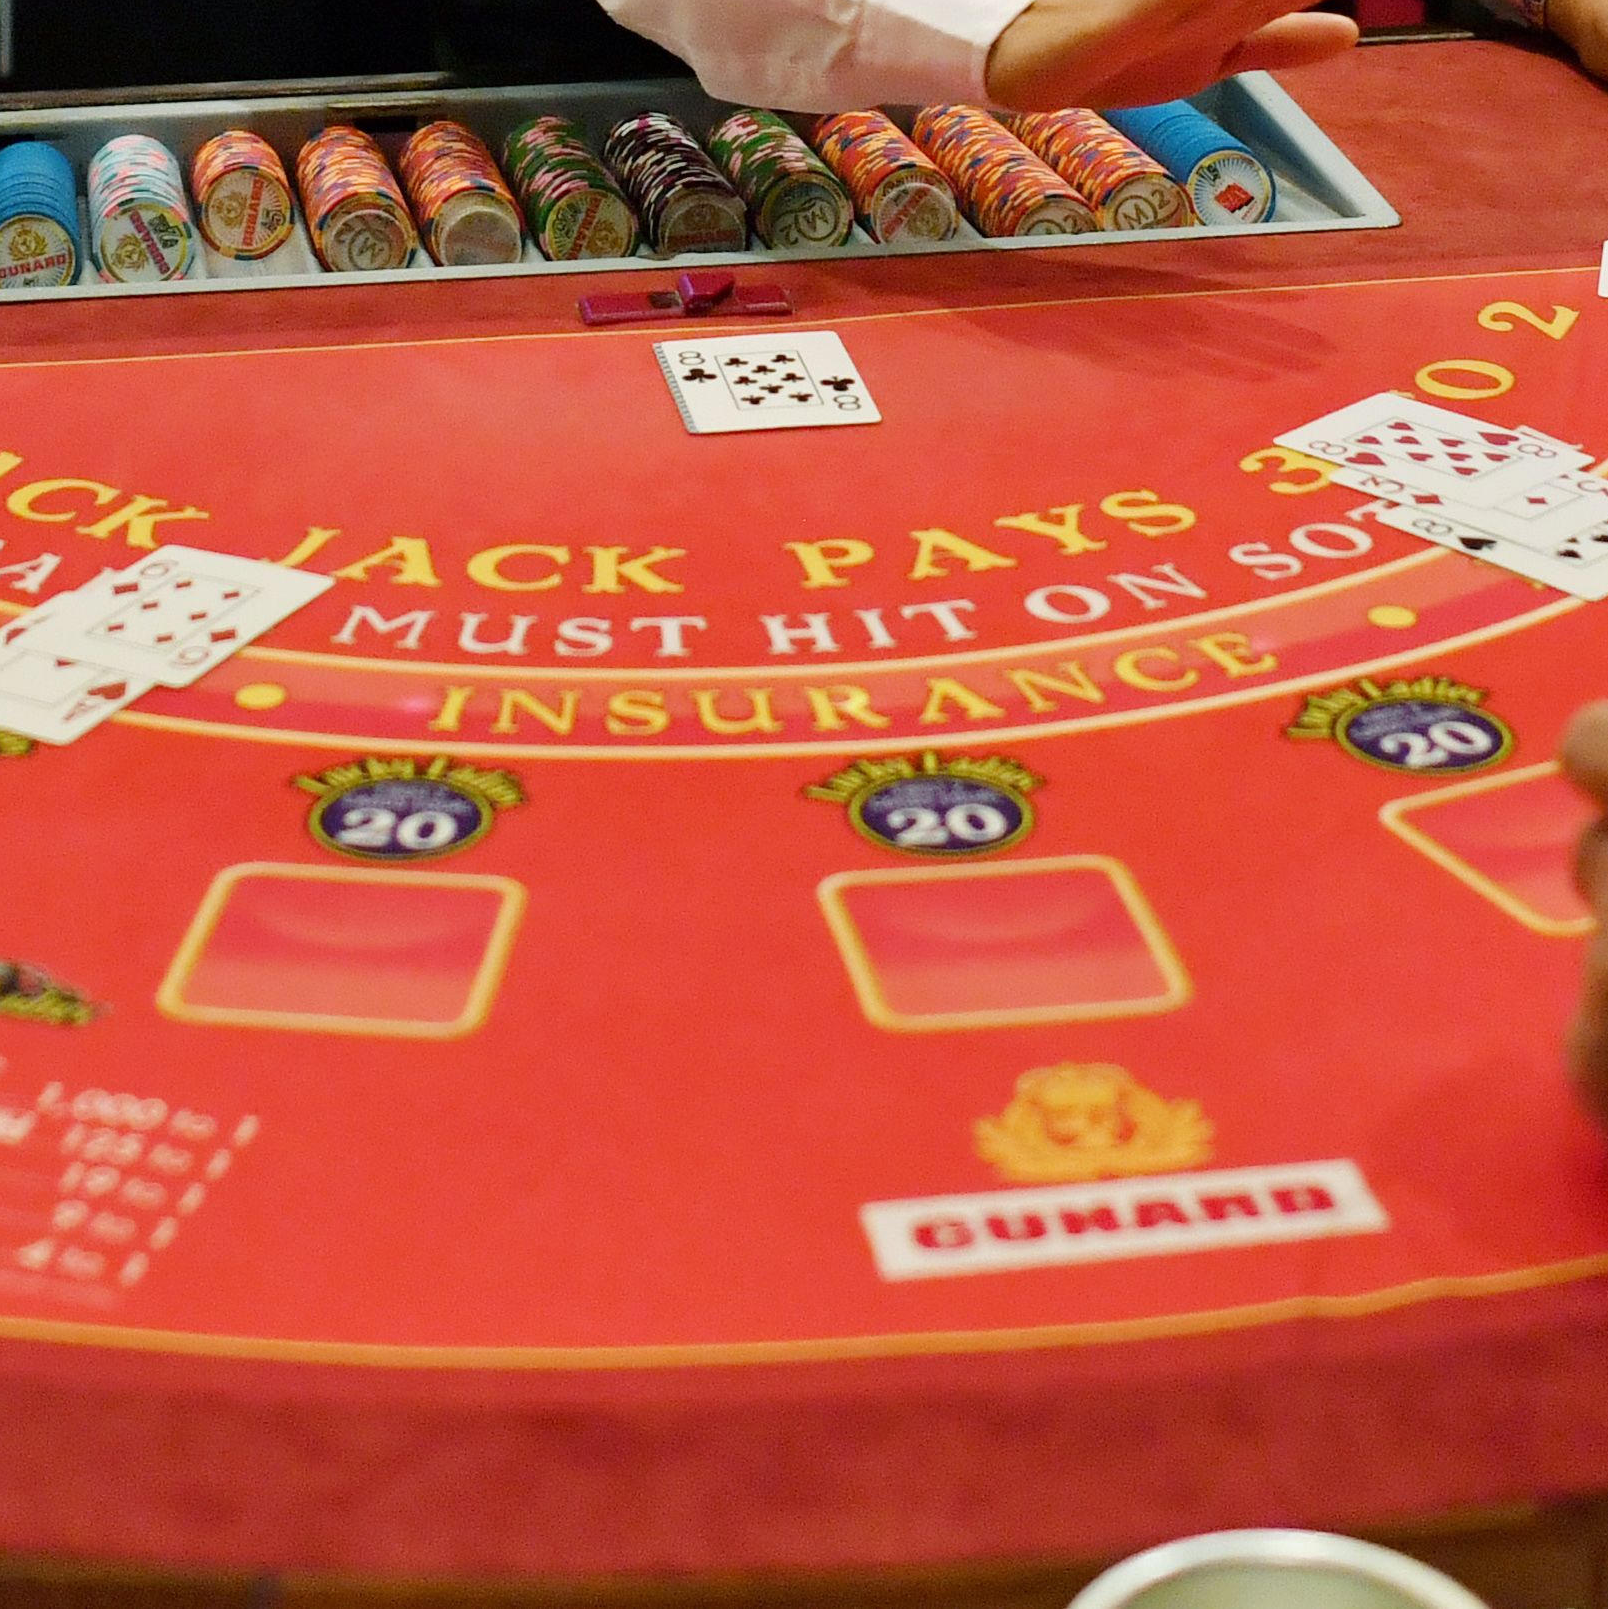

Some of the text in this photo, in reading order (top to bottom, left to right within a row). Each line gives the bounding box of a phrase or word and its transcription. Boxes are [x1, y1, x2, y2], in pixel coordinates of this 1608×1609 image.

[242, 177, 265, 247] CUNARD
[678, 350, 706, 366] 8
[832, 394, 862, 411] 8
[261, 526, 687, 594] JACK
[783, 489, 1197, 588] PAYS
[1391, 359, 1515, 400] O
[1477, 301, 1581, 341] 2
[1308, 438, 1348, 457] 8
[1517, 442, 1558, 460] 8
[1411, 516, 1454, 537] 8
[330, 604, 709, 658] MUST
[759, 597, 978, 655] HIT
[1024, 561, 1208, 625] ON
[429, 631, 1279, 736] INSURANCE
[1379, 720, 1494, 770] 20
[334, 807, 459, 850] 20
[886, 802, 1009, 847] 20
[233, 1113, 260, 1148] 1
[205, 1147, 233, 1181] 1
[177, 1181, 206, 1215] 1
[149, 1215, 179, 1251] 1
[912, 1185, 1335, 1250] CUNARD
[119, 1251, 150, 1287] 1
